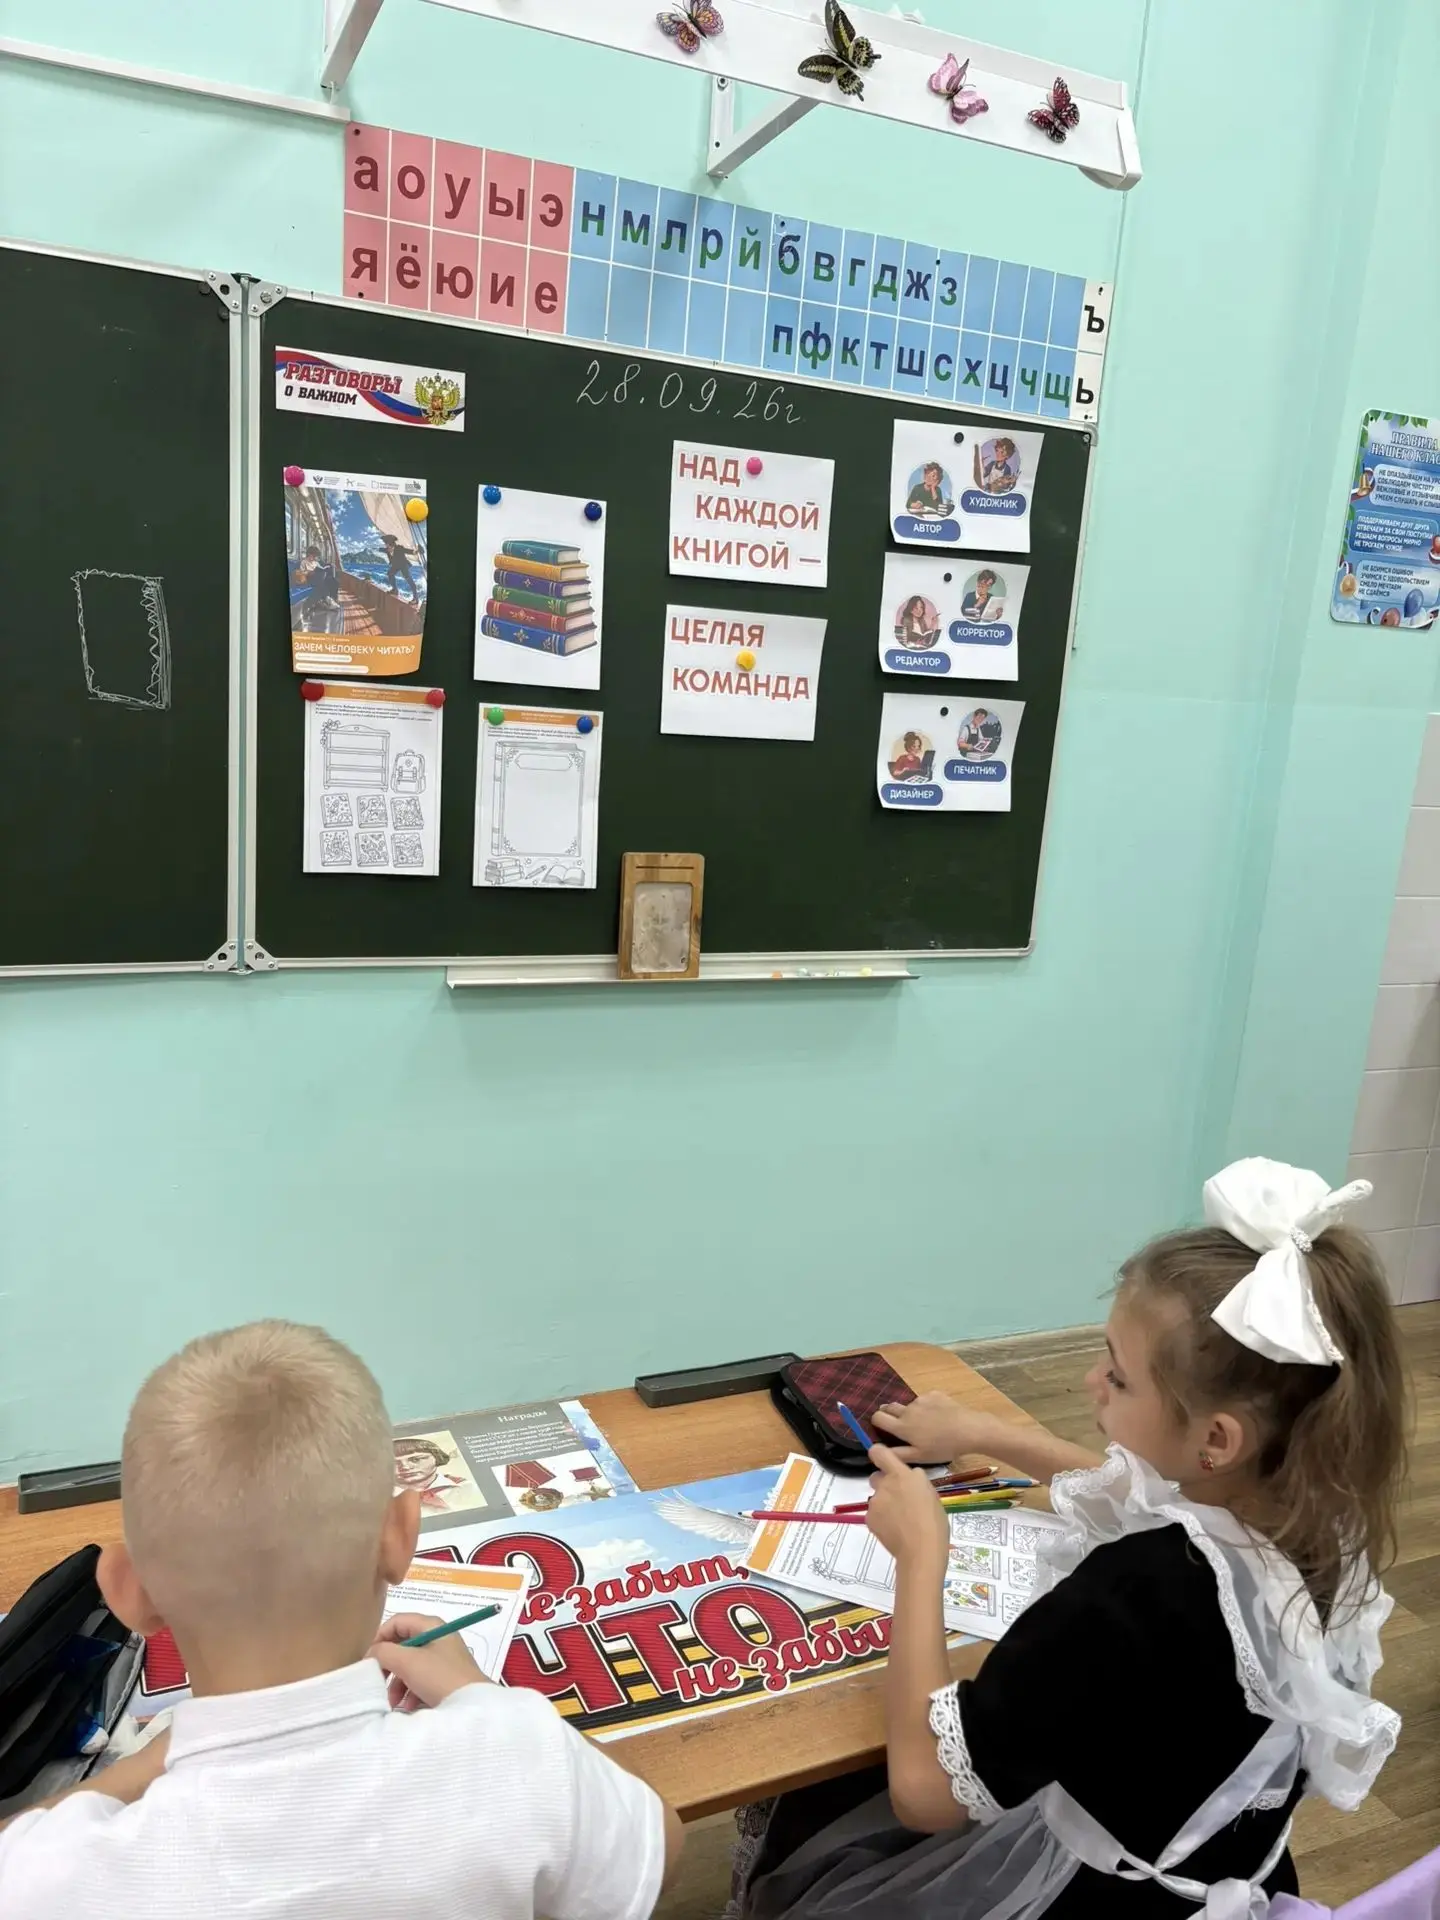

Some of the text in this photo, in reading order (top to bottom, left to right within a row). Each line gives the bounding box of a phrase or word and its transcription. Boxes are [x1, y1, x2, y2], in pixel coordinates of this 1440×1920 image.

[353, 155, 1105, 333] а о у ы э н м л р й б в г д ж з ъ
[350, 243, 1094, 407] я ё ю и е п ф к т ш с х ц ч щ ь
[284, 362, 403, 395] РАЗГОВОРЫ
[284, 385, 358, 405] О ВАЖНОМ
[1391, 431, 1438, 450] ПРАВИЛА
[1372, 443, 1414, 461] НАШЕГО
[678, 453, 741, 487] НАД
[695, 494, 819, 531] КАЖДОЙ
[969, 497, 1018, 509] ХУДОЖНИК
[913, 523, 942, 534] АВТОР
[673, 536, 789, 570] КНИГОЙ
[671, 617, 765, 648] ЦЕЛАЯ
[957, 627, 1005, 639] КОРРЕКТОР
[294, 642, 415, 656] ЗАЧЕМ ЧЕЛОВЕКУ ЧИТАТЬ?
[895, 656, 941, 667] РЕДАКТОР
[673, 668, 810, 701] КОМАНДА
[953, 765, 997, 775] ПЕЧАТНИК
[890, 788, 934, 799] ДИЗАЙНЕР
[497, 1411, 548, 1423] Награды
[566, 1559, 748, 1622] забыт,
[676, 1657, 741, 1703] не
